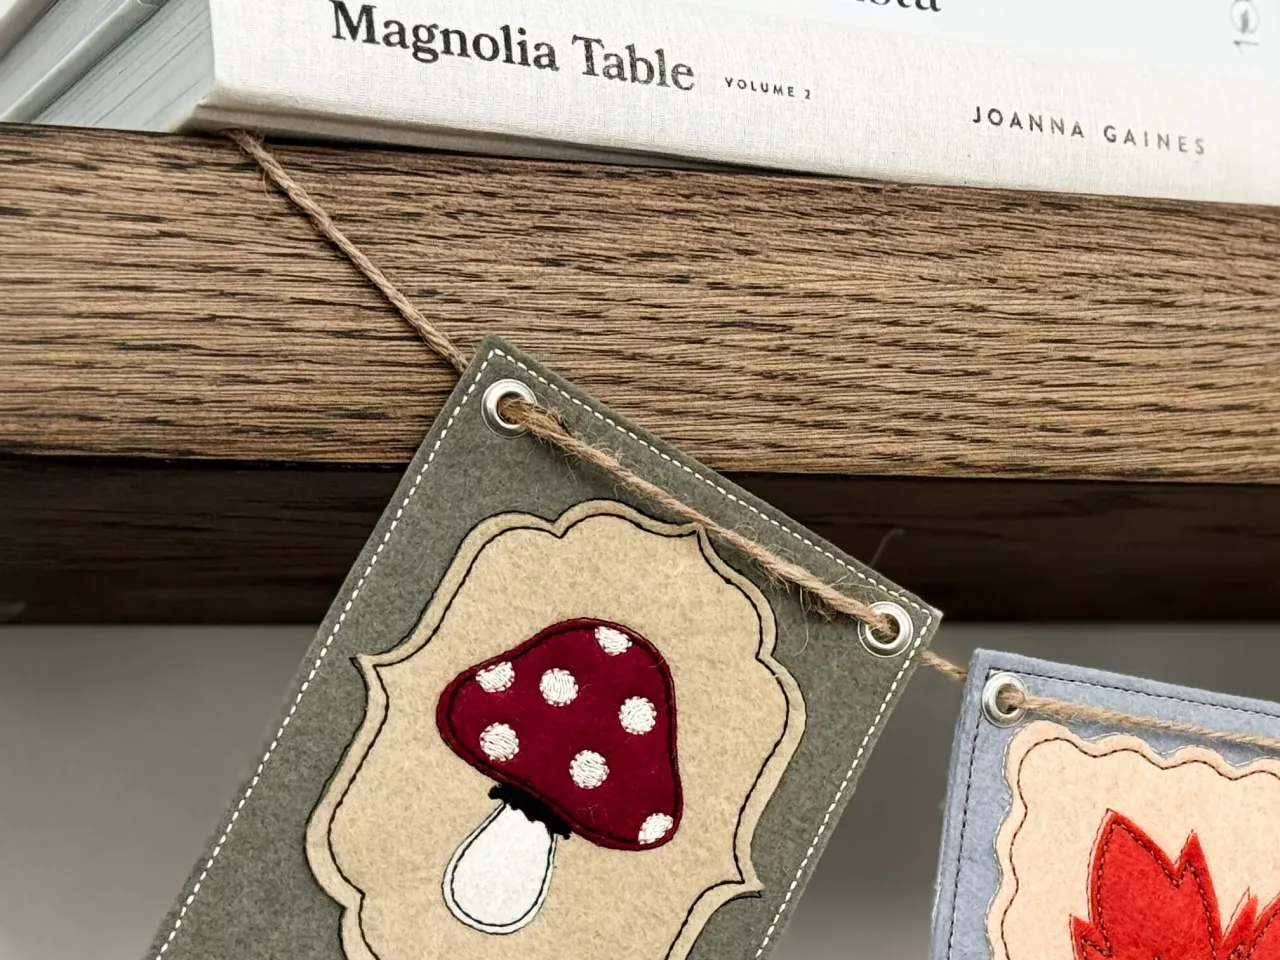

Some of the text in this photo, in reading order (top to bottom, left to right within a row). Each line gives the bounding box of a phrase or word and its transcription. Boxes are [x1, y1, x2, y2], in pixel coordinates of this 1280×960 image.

[329, 0, 695, 91] Magnolia Table
[724, 77, 812, 100] VOLUME 2
[972, 106, 1206, 155] JOANNA GAINES
